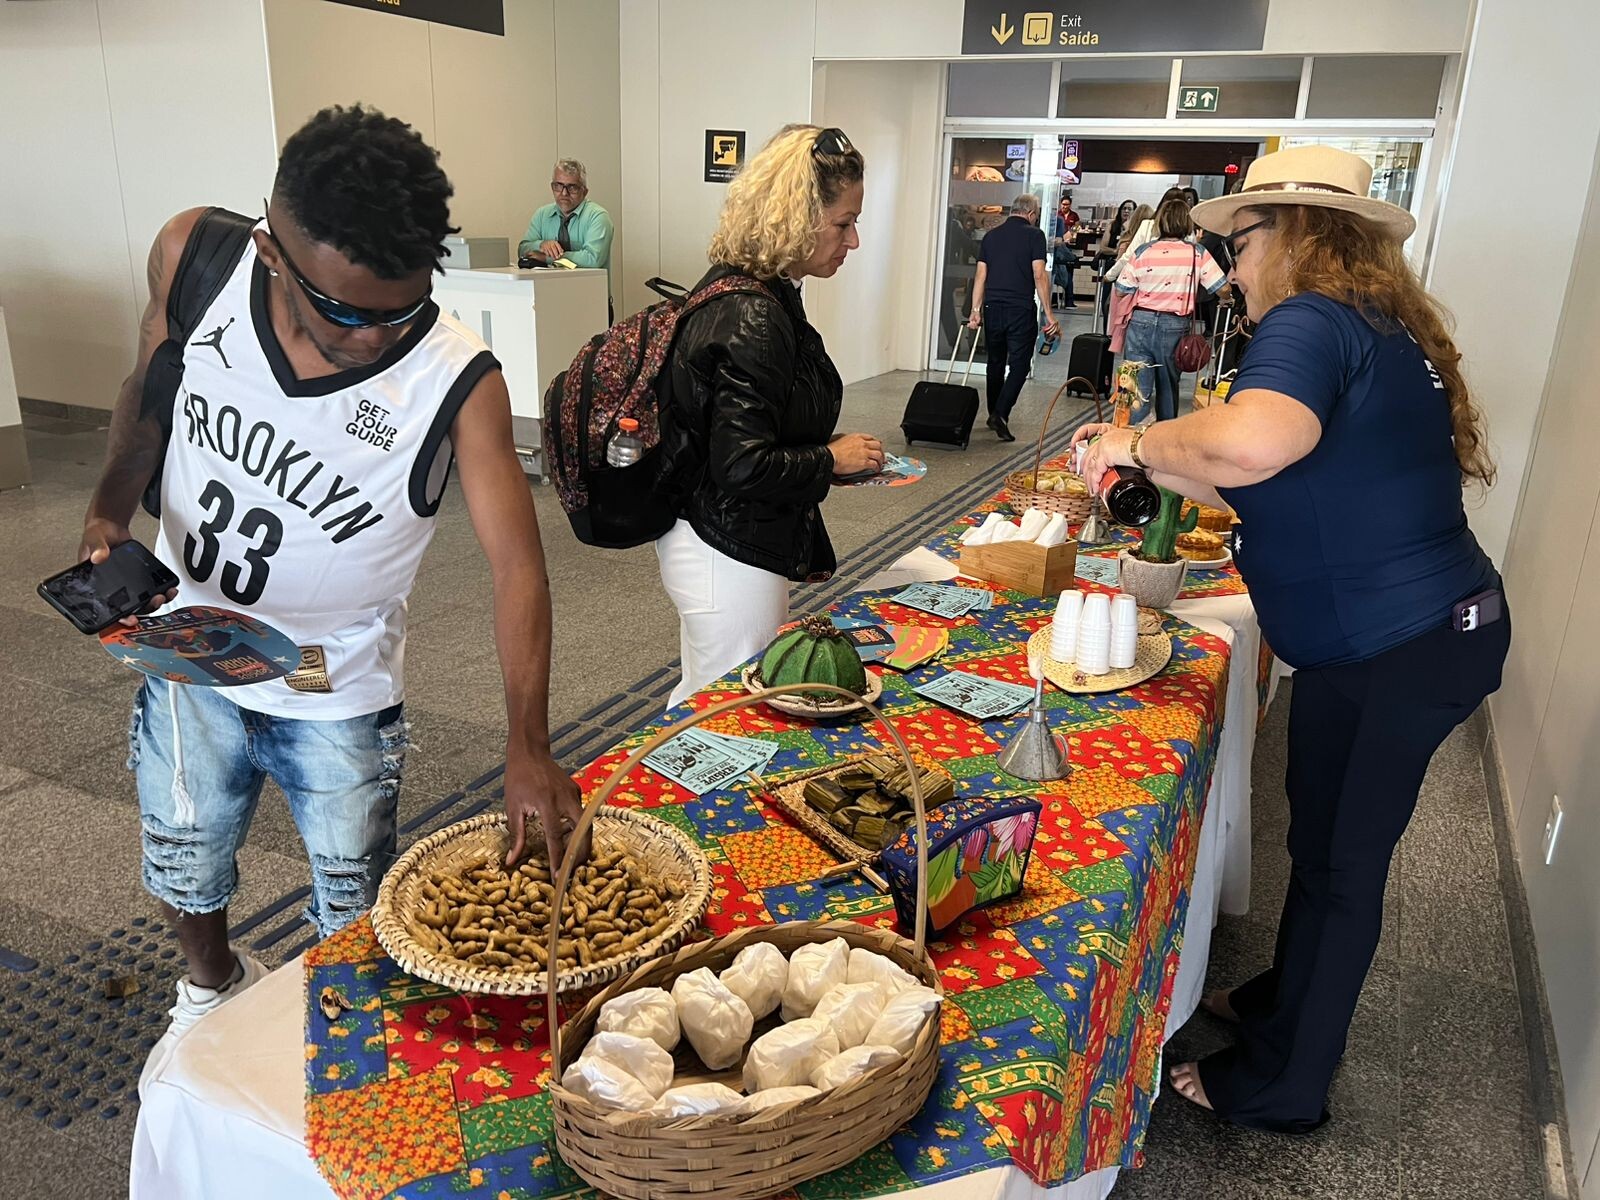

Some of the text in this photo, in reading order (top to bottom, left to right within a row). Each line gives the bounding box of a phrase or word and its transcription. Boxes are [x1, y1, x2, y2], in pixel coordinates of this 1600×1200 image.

[1060, 14, 1082, 28] Exit
[1059, 31, 1099, 46] Saída
[359, 399, 390, 421] GET
[355, 409, 398, 439] YOUR
[345, 422, 394, 452] GUIDE
[183, 479, 284, 606] 33
[703, 764, 738, 786] SERGIPE
